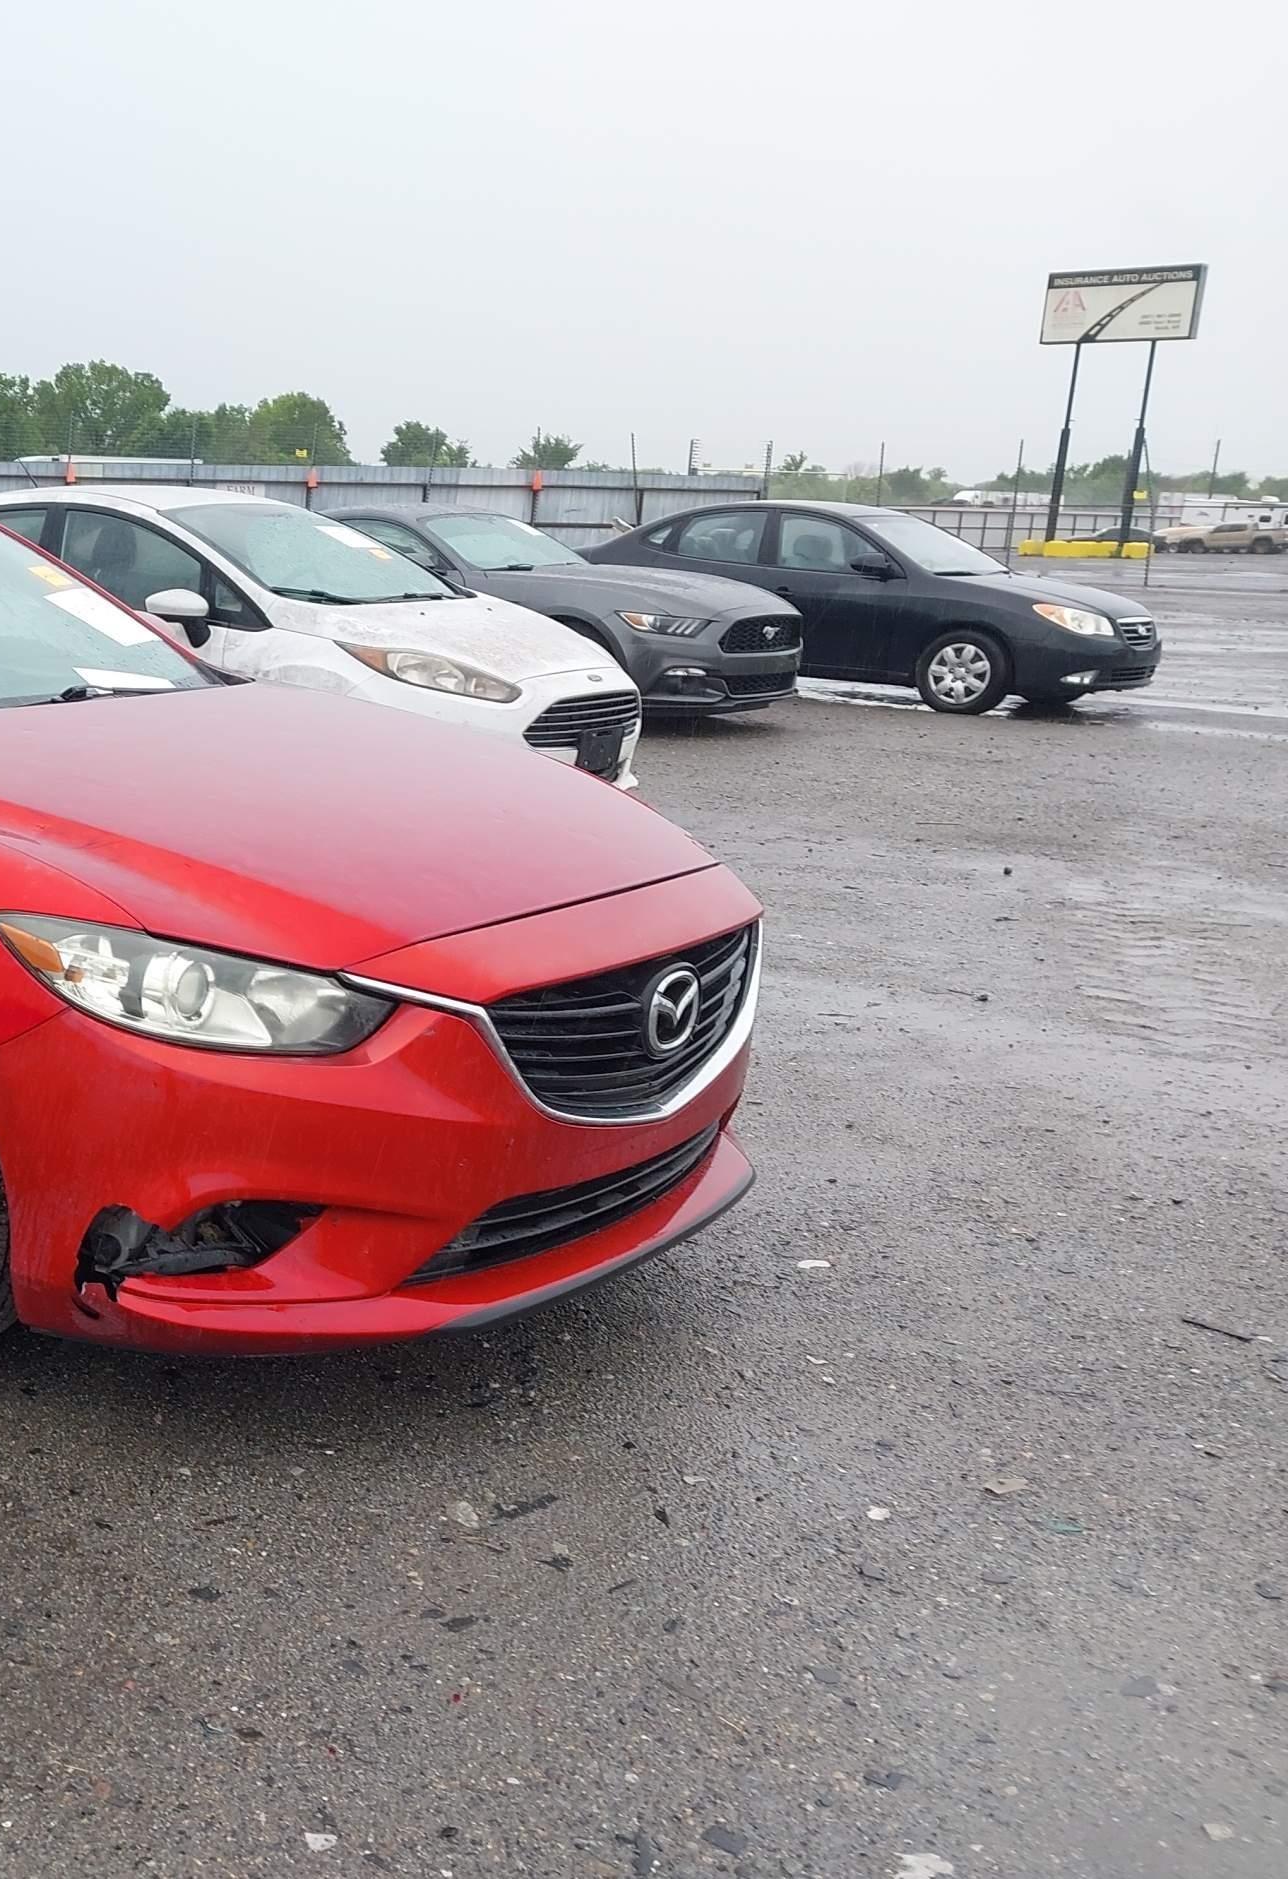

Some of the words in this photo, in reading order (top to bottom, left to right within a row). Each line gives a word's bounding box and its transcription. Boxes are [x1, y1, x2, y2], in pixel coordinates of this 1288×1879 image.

[1054, 275, 1110, 286] INSURANCE
[1112, 273, 1139, 283] AUTO
[1141, 270, 1193, 281] AUCTIONS
